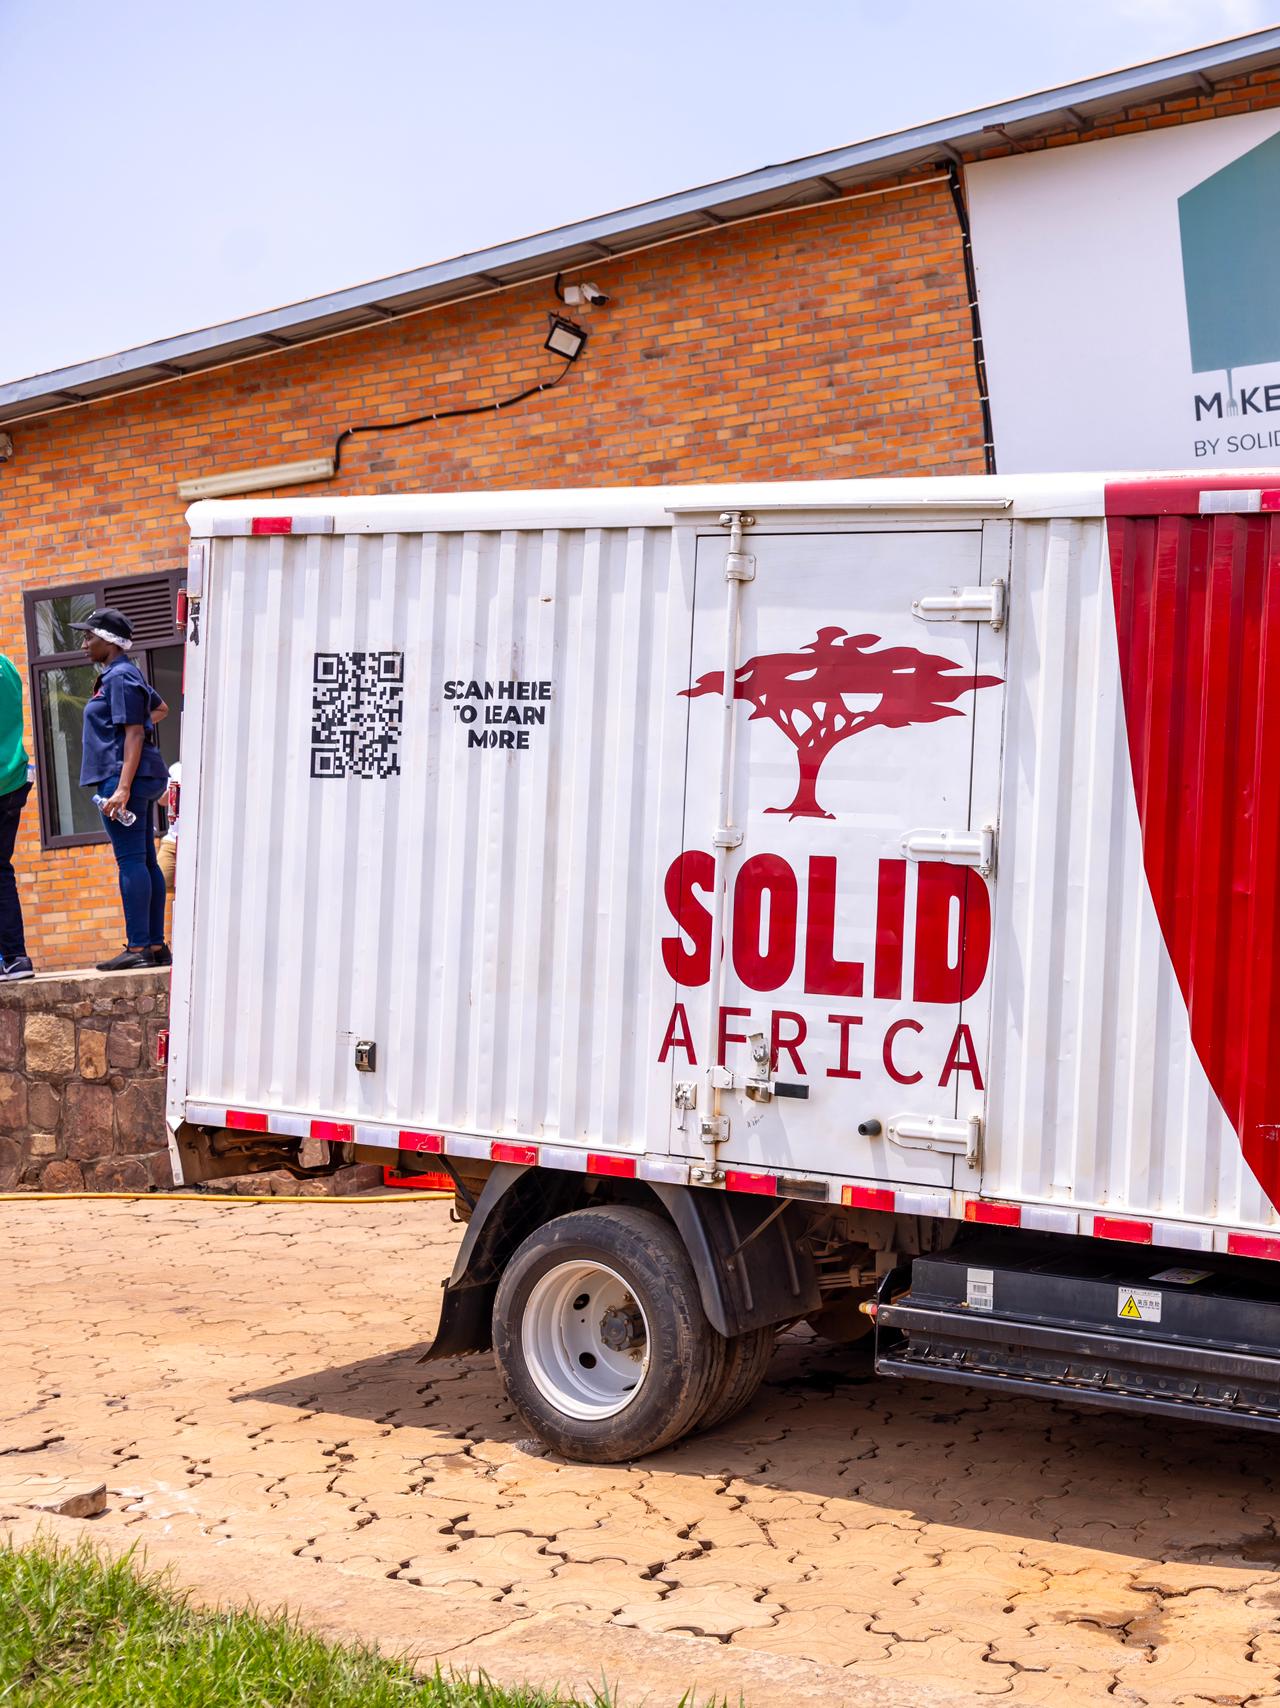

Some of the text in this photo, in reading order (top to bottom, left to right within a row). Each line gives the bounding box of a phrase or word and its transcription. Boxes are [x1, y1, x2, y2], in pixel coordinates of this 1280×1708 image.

[1194, 438, 1220, 457] BY
[485, 705, 545, 725] LEARN
[468, 729, 530, 750] MORE
[661, 850, 992, 1004] SOLID
[658, 1002, 985, 1090] AFRICA
